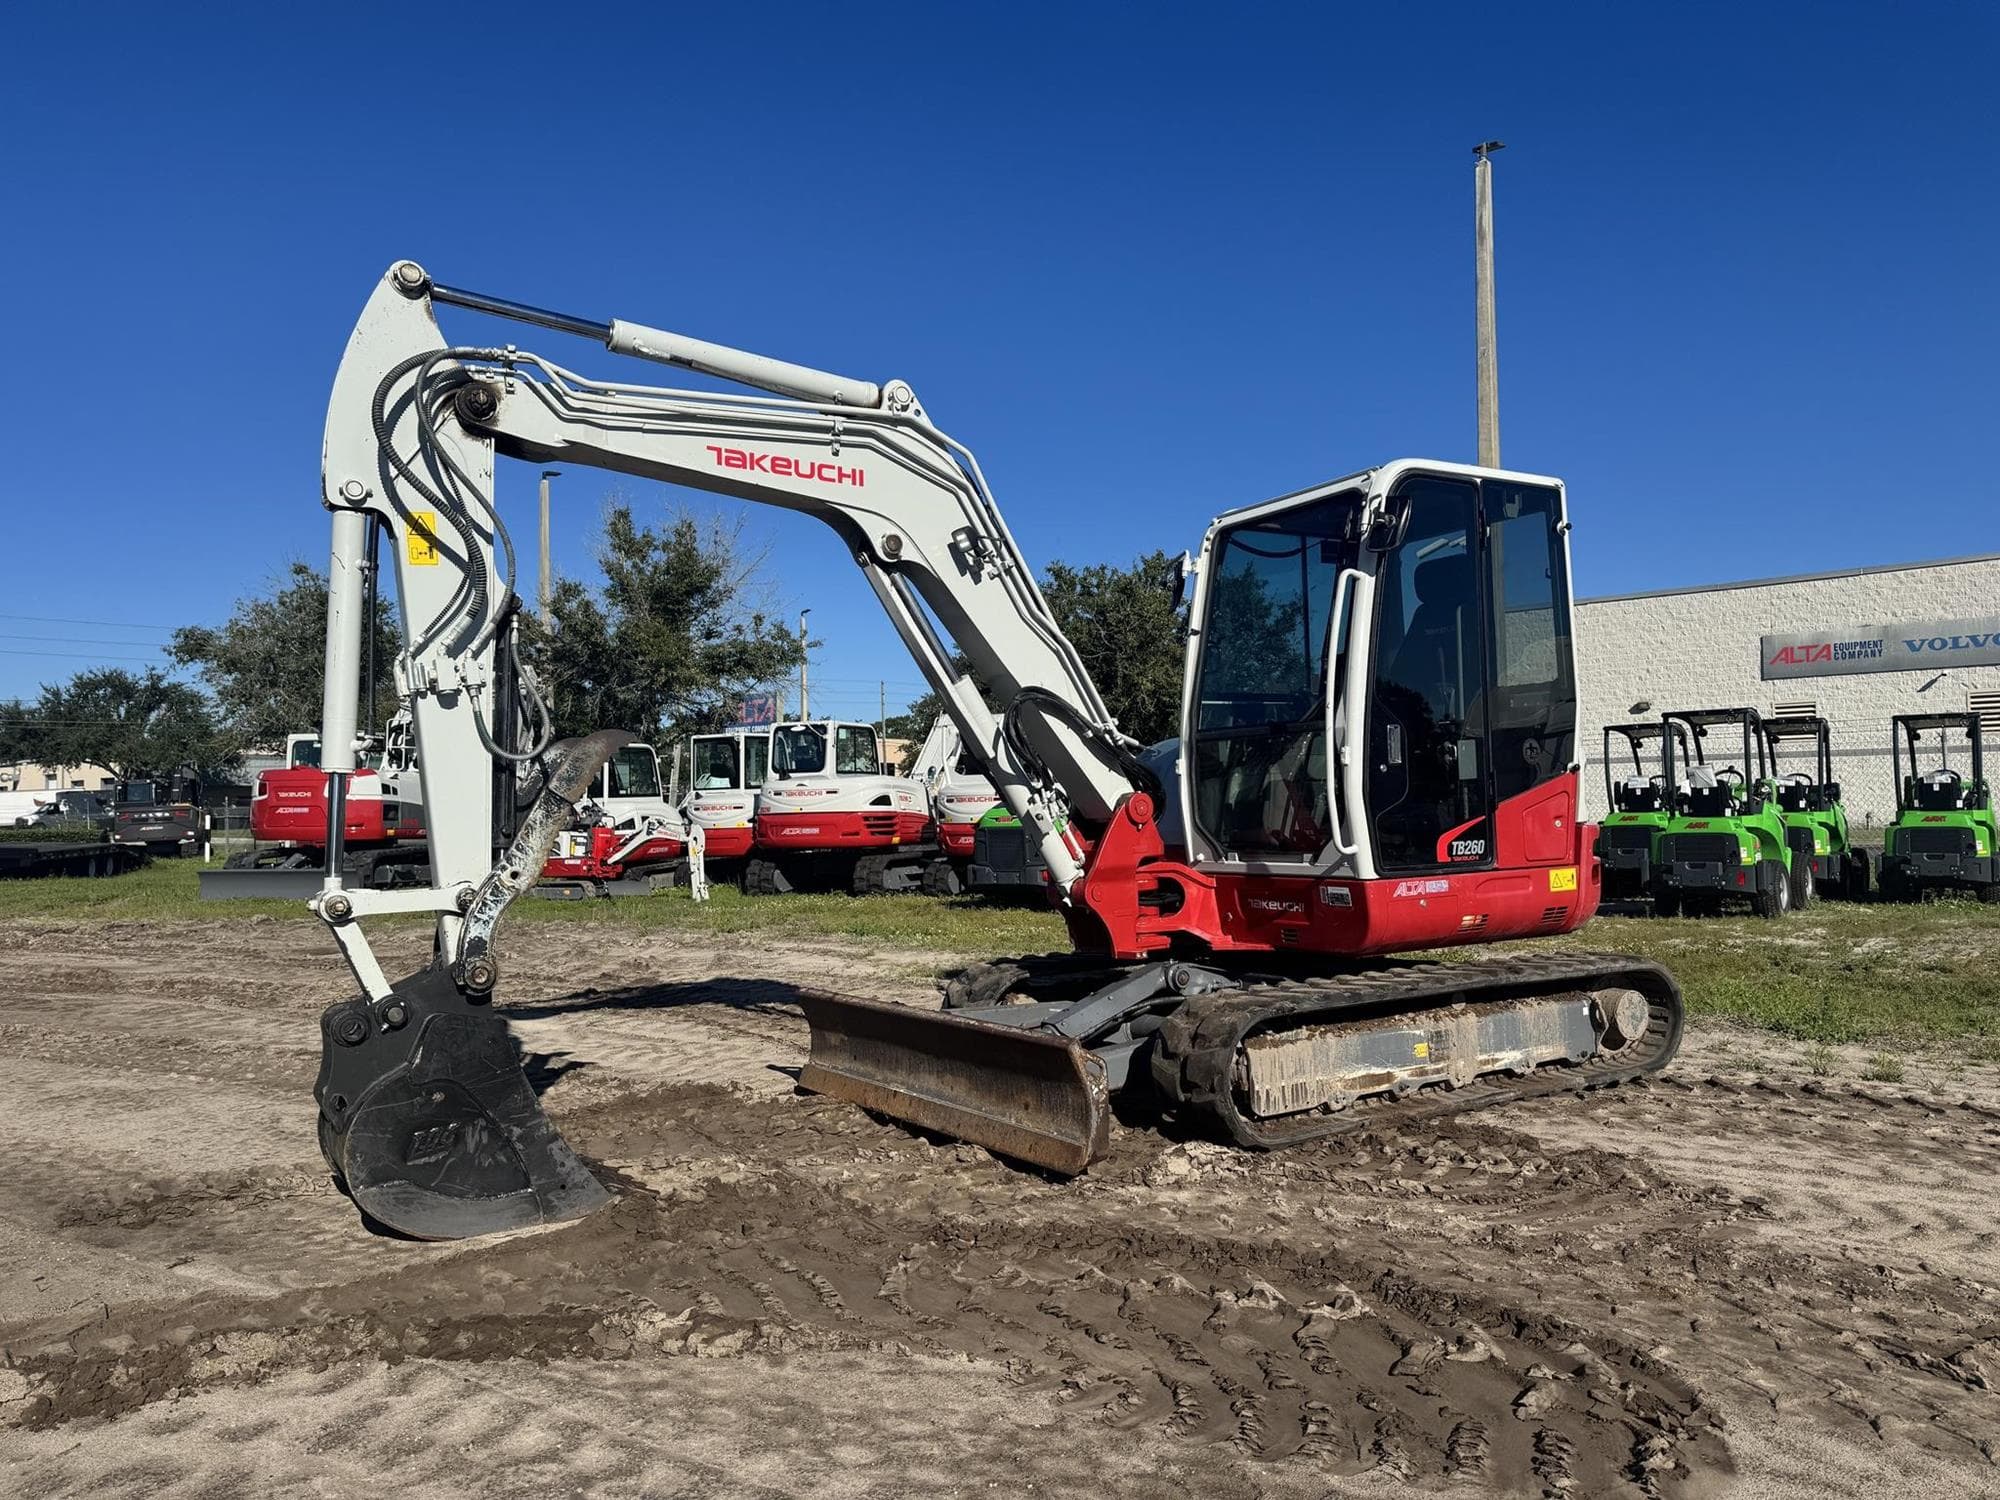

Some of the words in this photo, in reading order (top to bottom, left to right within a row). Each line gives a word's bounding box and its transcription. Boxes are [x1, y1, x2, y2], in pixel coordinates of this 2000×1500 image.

[1833, 639, 1884, 650] EQUIPMENT
[1770, 643, 1832, 665] ALTA
[1833, 649, 1884, 661] COMPANY
[1451, 839, 1485, 856] TB260
[1393, 881, 1426, 898] ALTA
